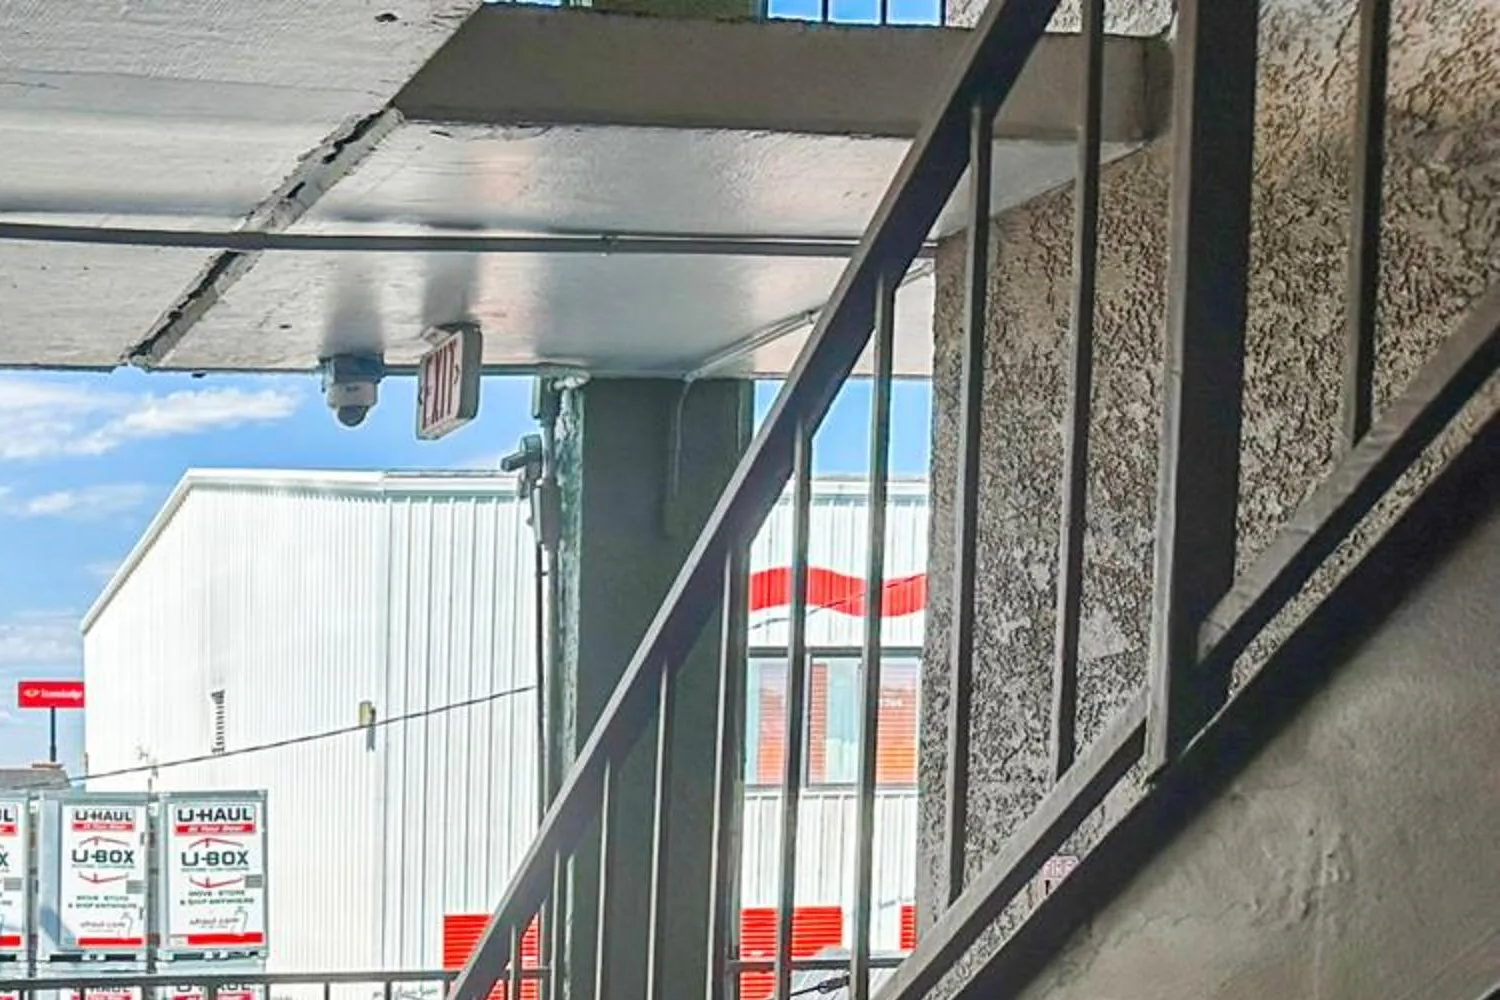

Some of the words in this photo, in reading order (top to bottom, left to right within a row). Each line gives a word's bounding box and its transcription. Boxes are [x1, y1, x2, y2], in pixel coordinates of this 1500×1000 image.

[75, 811, 133, 821] U-HAUL
[177, 807, 253, 822] U-HAUL
[72, 849, 135, 864] U-BOX
[181, 849, 249, 867] U-BOX
